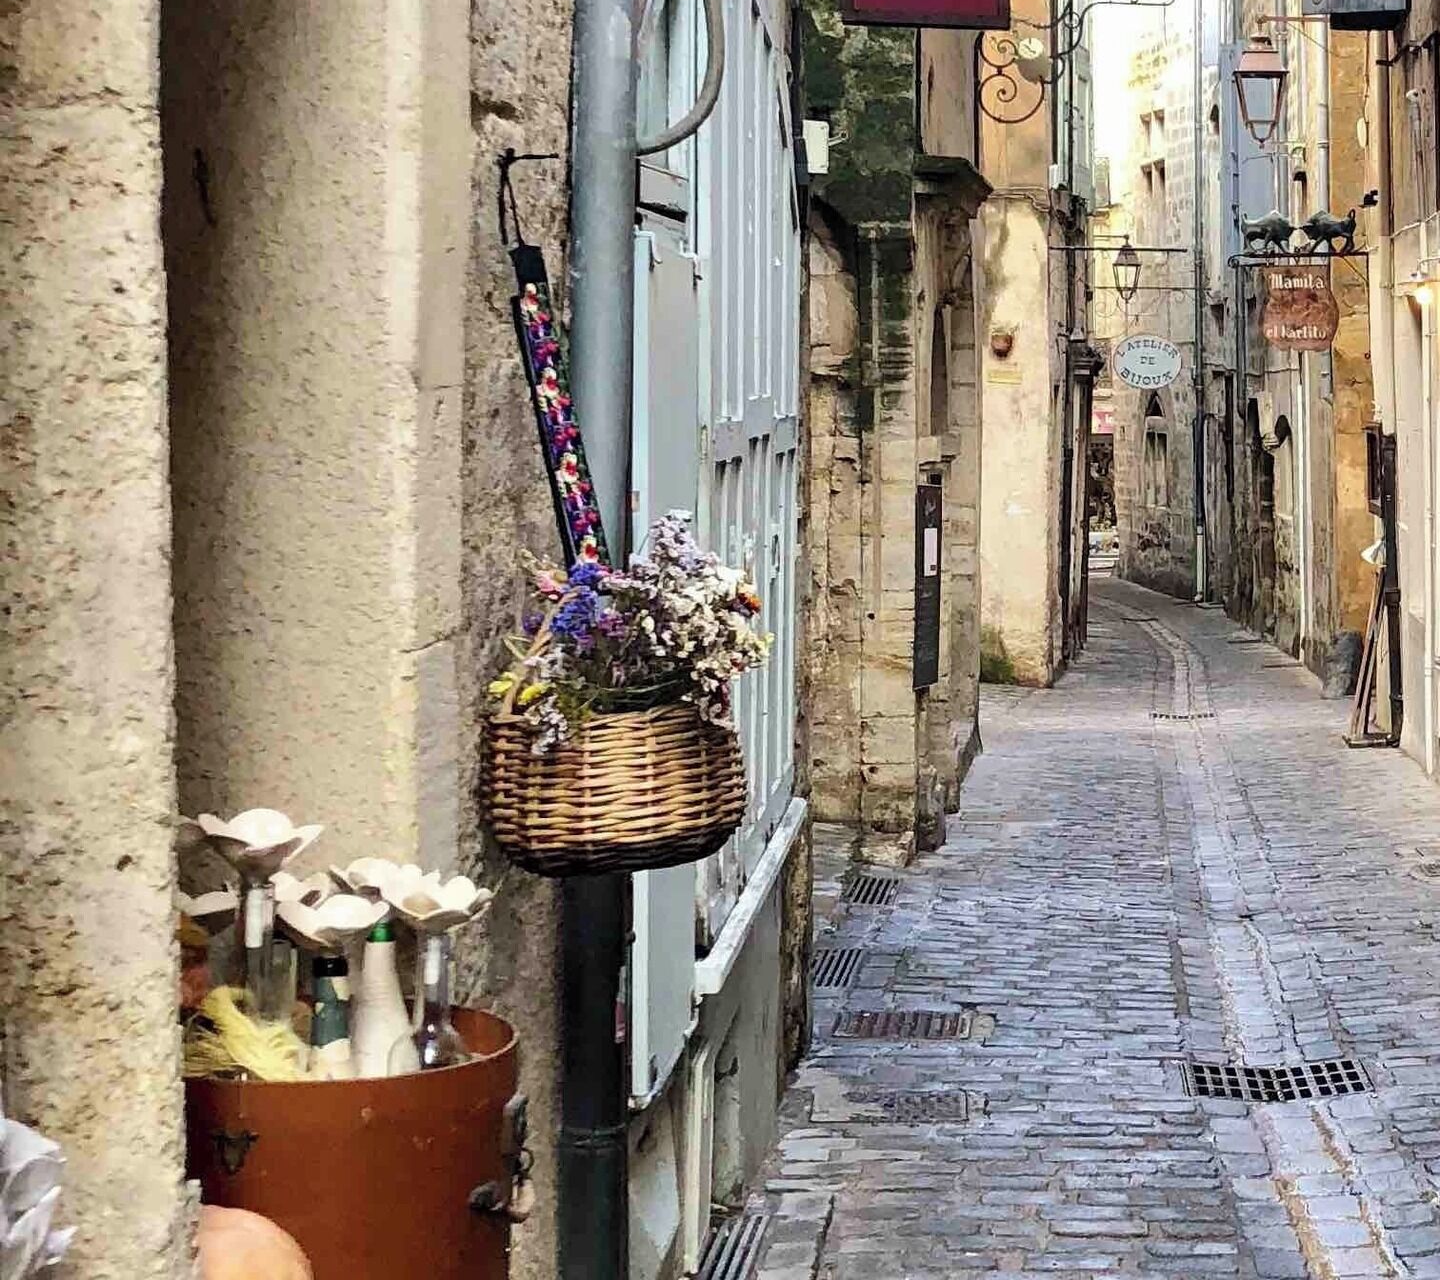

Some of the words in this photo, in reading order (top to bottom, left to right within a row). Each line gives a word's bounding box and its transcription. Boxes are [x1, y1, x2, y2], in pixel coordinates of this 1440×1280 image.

[1116, 339, 1178, 359] LATELIER
[1140, 356, 1156, 365] DE
[1120, 366, 1173, 386] BIJOUX
